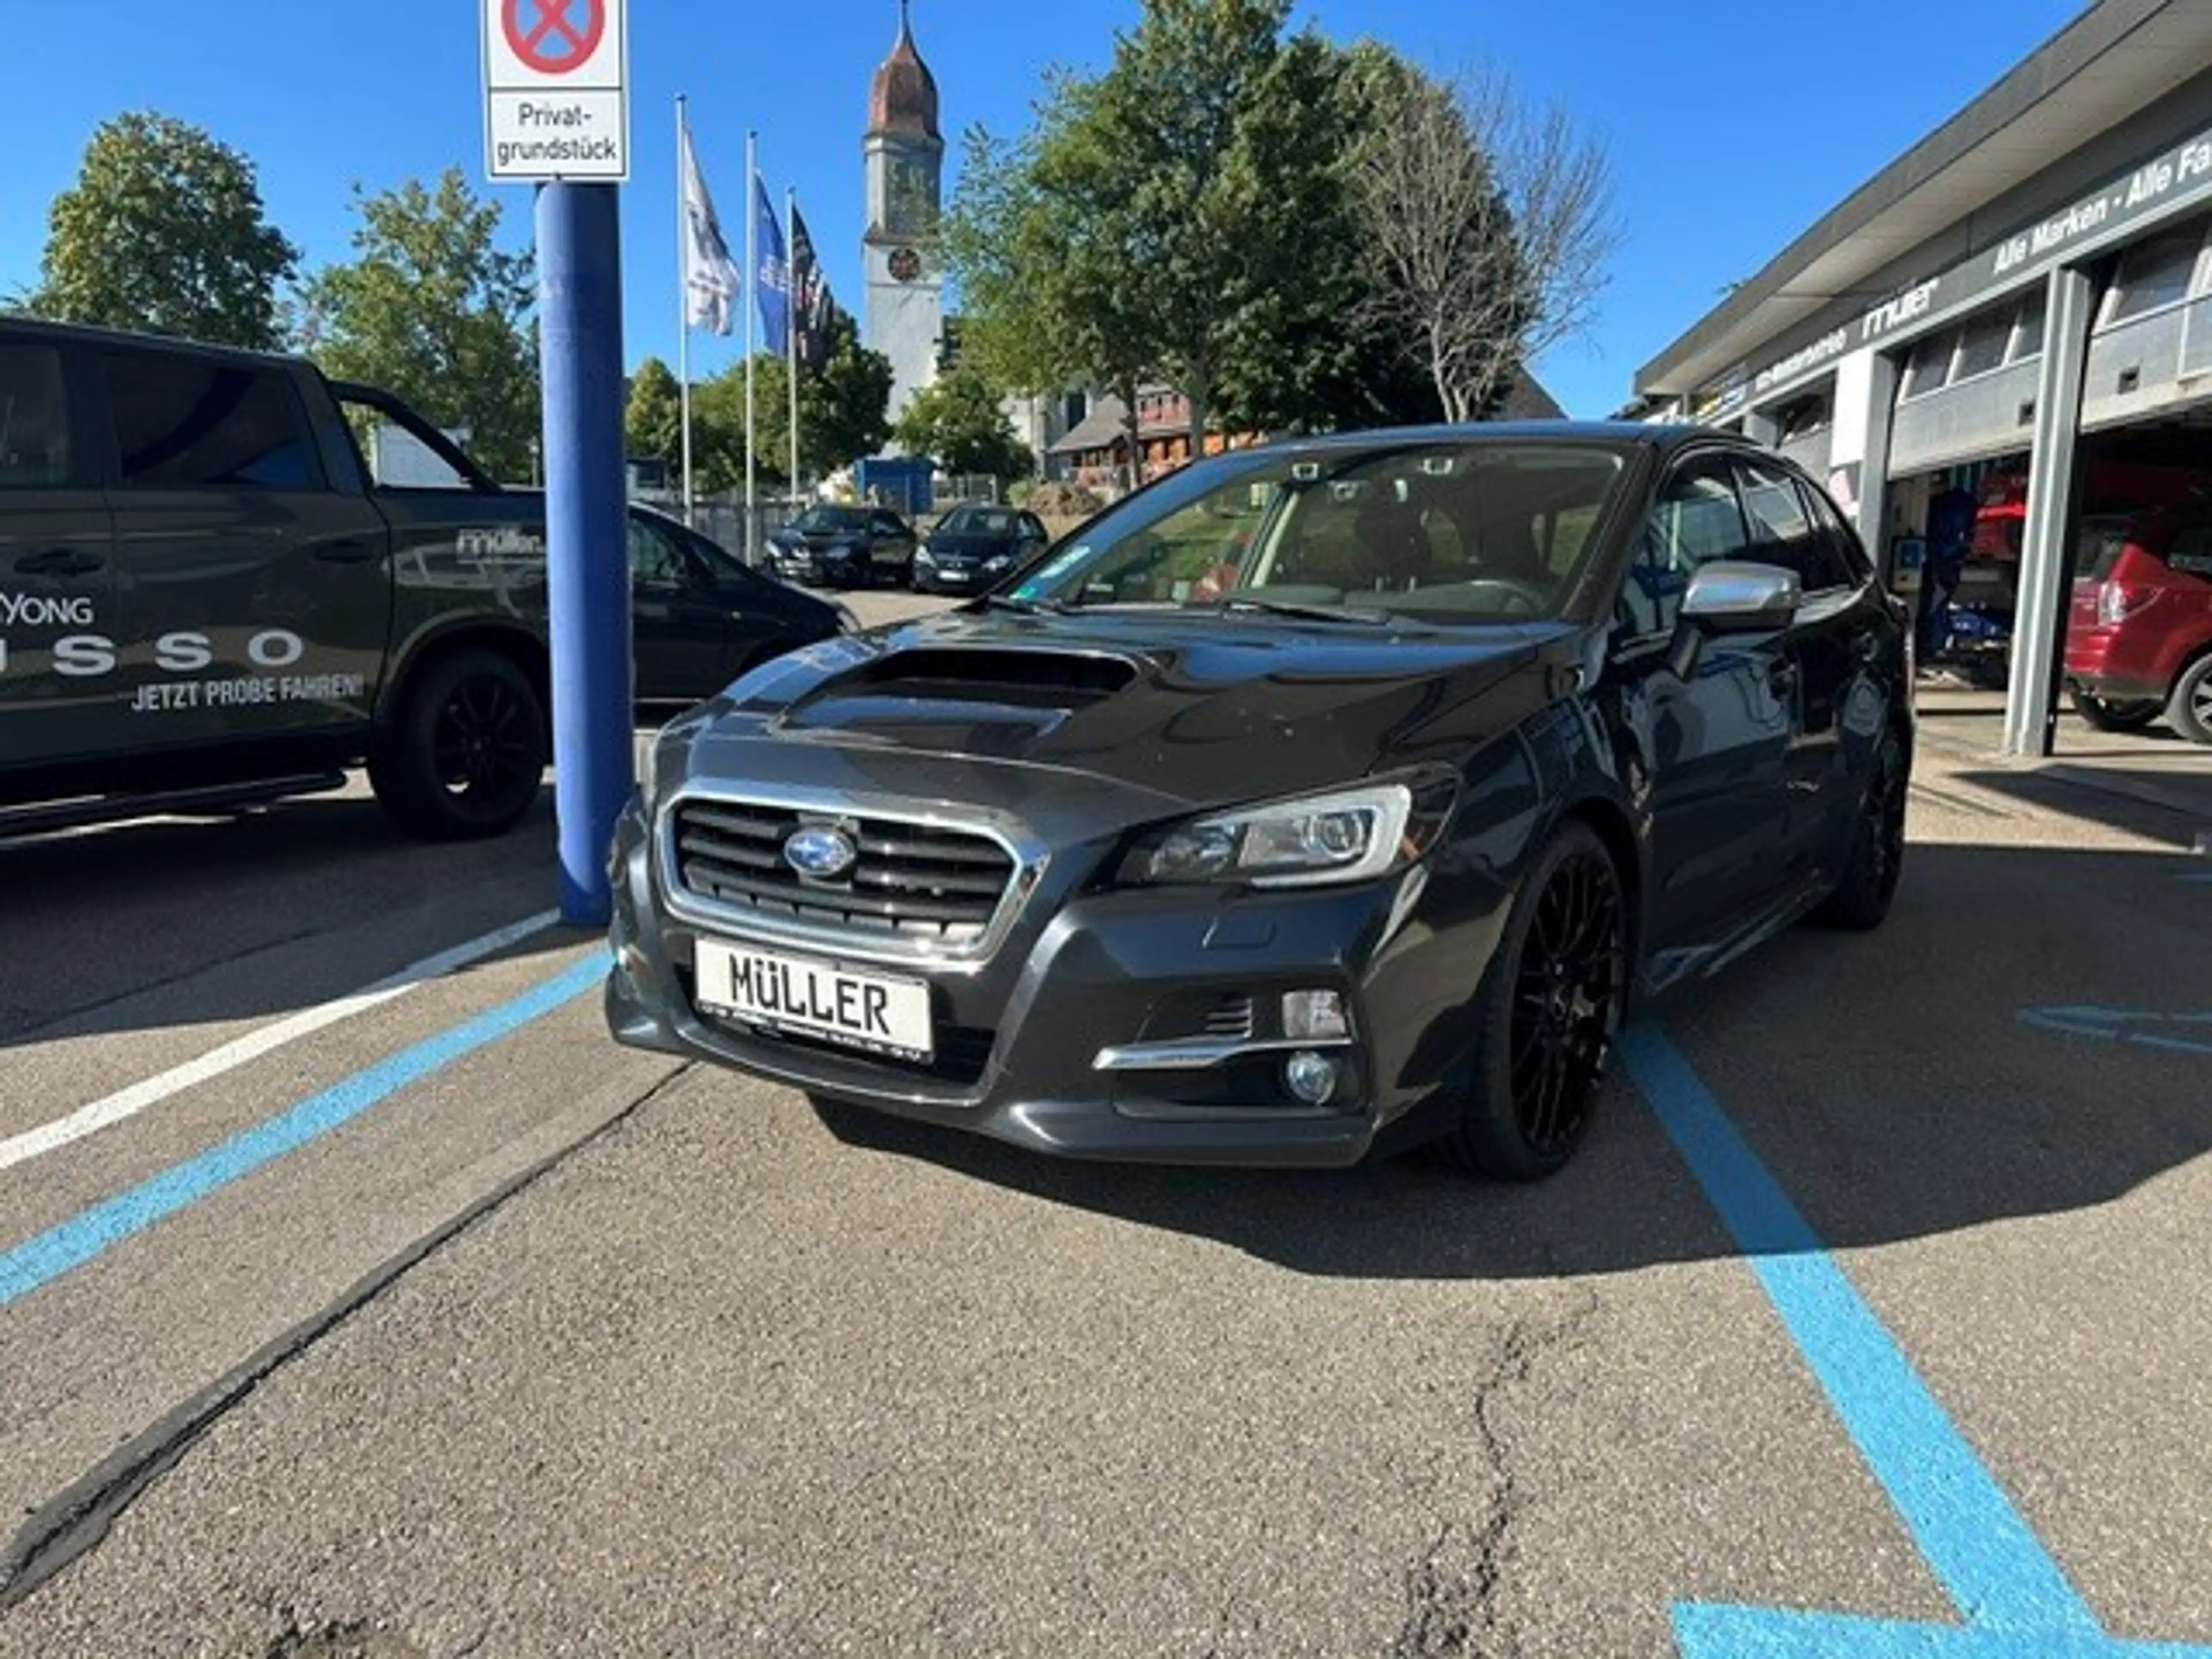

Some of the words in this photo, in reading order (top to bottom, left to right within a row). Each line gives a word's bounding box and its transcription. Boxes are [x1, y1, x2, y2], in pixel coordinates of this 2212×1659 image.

[518, 102, 592, 126] Privat-
[497, 136, 616, 167] grundstück
[2125, 162, 2172, 209] Alle
[2177, 142, 2212, 183] Fa
[0, 592, 94, 626] YONG
[0, 628, 304, 676] SSO
[131, 681, 202, 712] JETZT
[206, 676, 276, 707] PROBE
[728, 952, 891, 1036] MÜLLER
